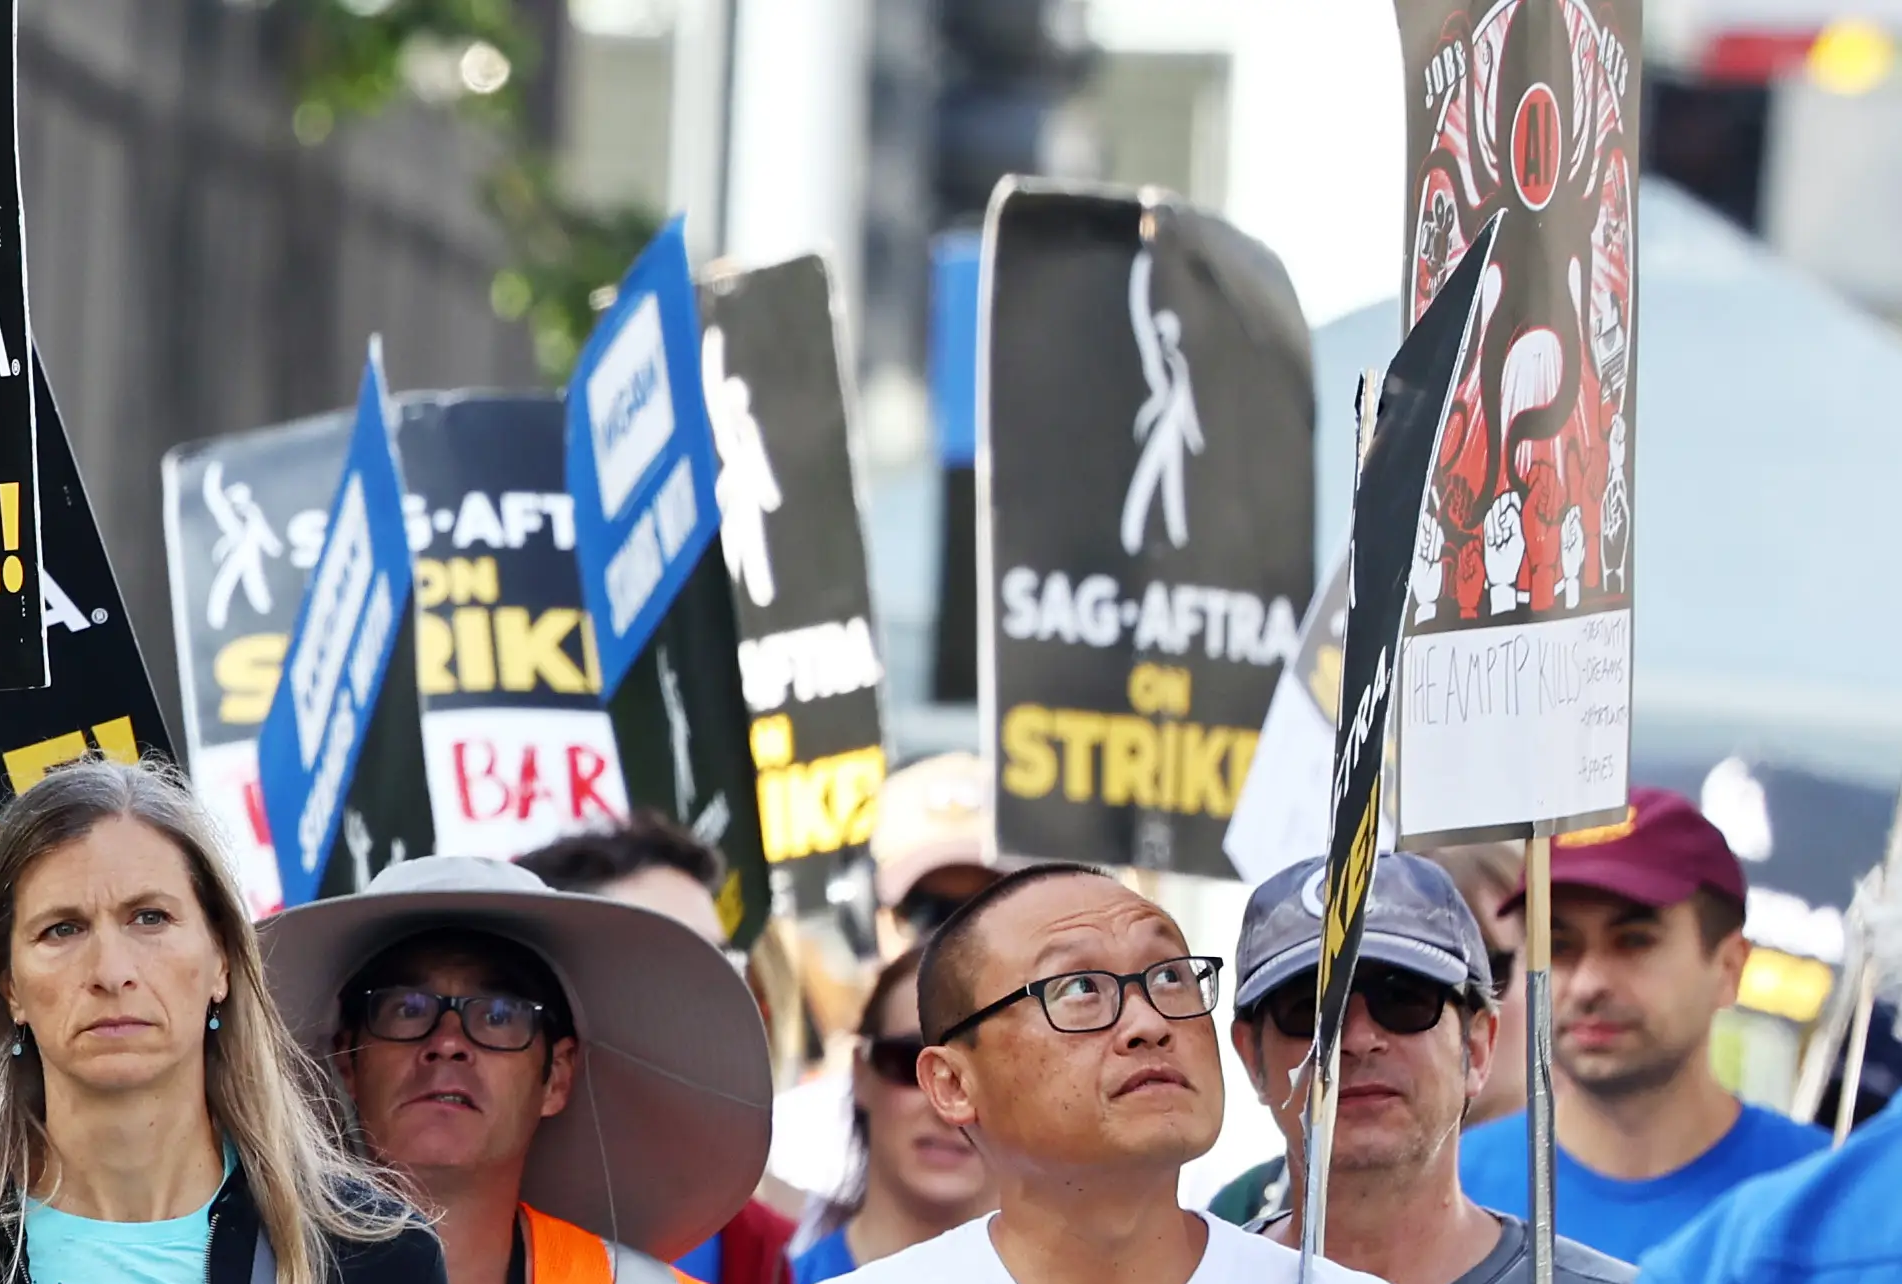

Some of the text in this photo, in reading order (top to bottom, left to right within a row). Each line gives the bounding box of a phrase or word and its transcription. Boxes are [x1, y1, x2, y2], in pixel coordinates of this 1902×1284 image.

[1424, 40, 1464, 109] JOBS
[1523, 101, 1553, 188] AI
[1127, 661, 1190, 718] ON
[1445, 634, 1529, 725] AMPTP
[1537, 637, 1582, 714] KILLS
[452, 738, 631, 824] BAR
